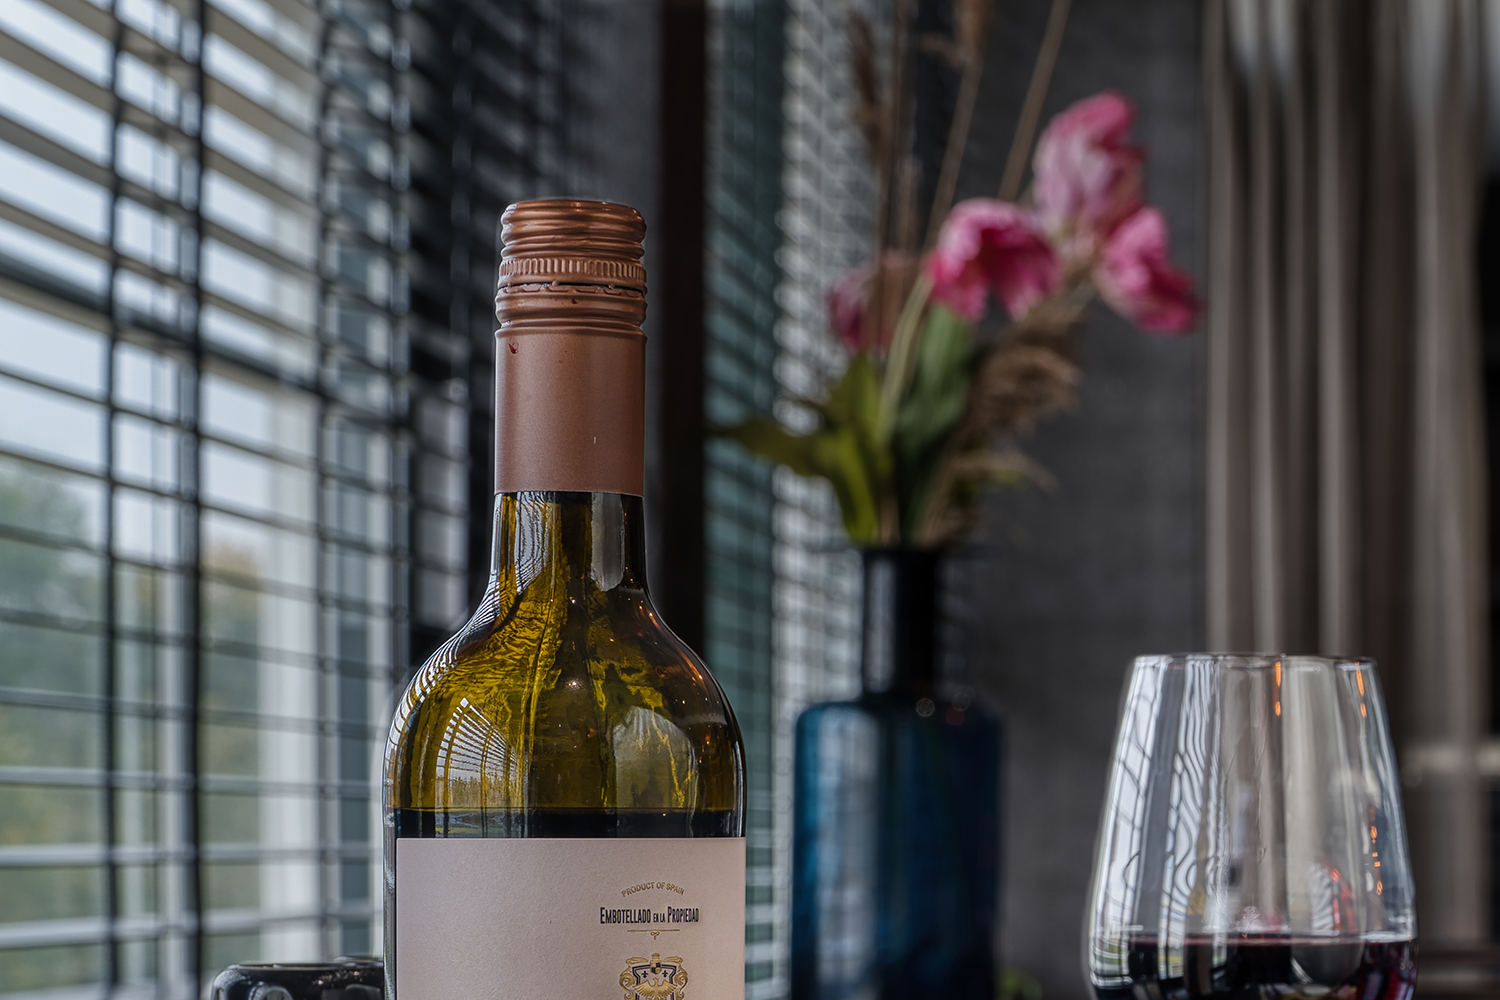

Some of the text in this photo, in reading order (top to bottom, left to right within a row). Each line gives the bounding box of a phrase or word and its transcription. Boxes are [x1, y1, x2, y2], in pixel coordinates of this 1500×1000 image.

[621, 882, 685, 898] PRODUCT OF SPAIN
